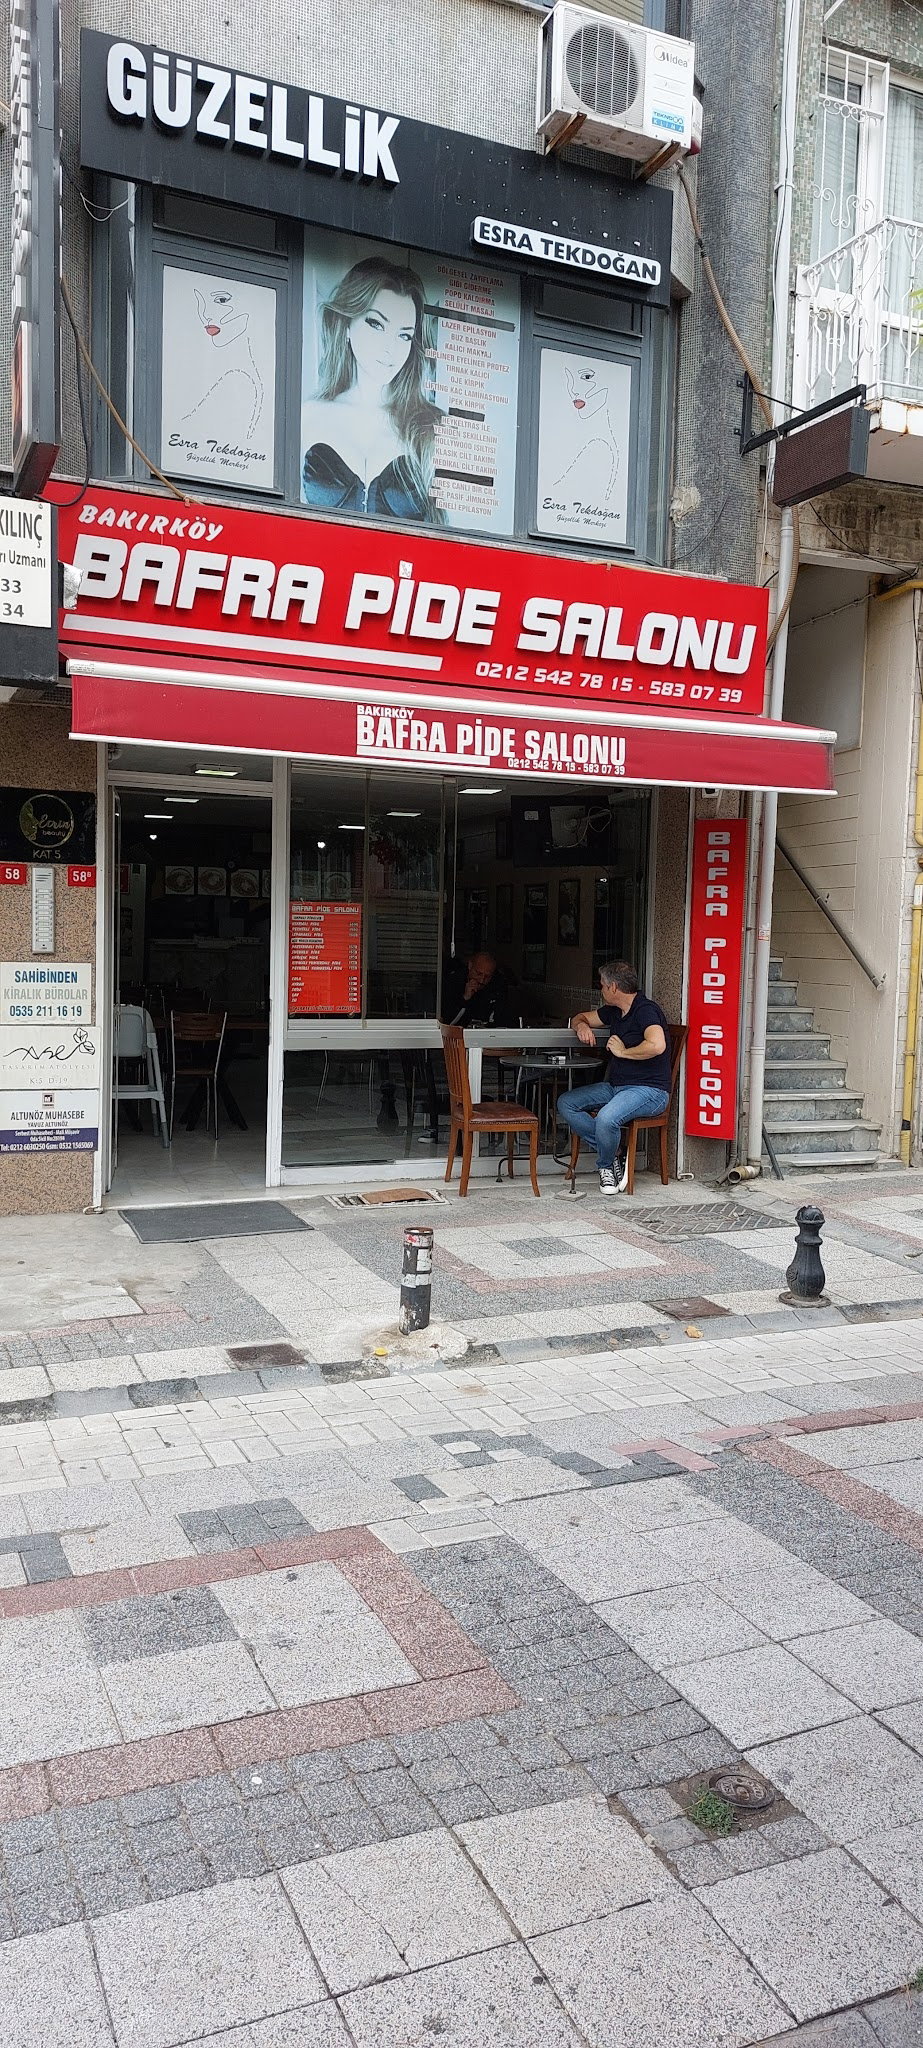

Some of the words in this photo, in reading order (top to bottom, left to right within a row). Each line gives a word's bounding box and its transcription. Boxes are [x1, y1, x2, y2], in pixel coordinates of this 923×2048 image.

[656, 48, 688, 68] Midea
[107, 42, 401, 184] GÜZELLİK
[479, 221, 533, 252] ESRA
[540, 238, 656, 281] TEKDOĞAN
[444, 289, 462, 299] POPO
[470, 305, 495, 317] MASAJI
[441, 320, 461, 330] LAZER
[462, 324, 497, 339] EPİLASYON
[451, 333, 464, 342] BUZ
[466, 347, 492, 359] MAKYAJ
[168, 433, 199, 450] Esra
[206, 440, 267, 462] Tekdoğan
[186, 452, 216, 464] Güzellik
[220, 457, 250, 471] Merkezi
[542, 497, 567, 512] Esra
[573, 502, 621, 521] Tekdoğan
[78, 504, 223, 542] BAKIRKÖY
[8, 549, 46, 569] Uzmanı
[0, 578, 22, 594] 33
[2, 602, 24, 618] 34
[72, 533, 325, 625] BAFRA
[344, 559, 501, 646] PİDE
[516, 596, 758, 675] SALONU
[475, 661, 527, 682] 0212
[533, 667, 572, 687] 542
[578, 672, 604, 689] 78
[610, 676, 634, 692] 15
[648, 680, 686, 698] 583
[690, 684, 715, 701] 07
[718, 688, 743, 704] 39
[356, 704, 414, 720] BAKIRKÖY
[356, 715, 447, 753] BAFRA
[456, 718, 516, 758] PİDE
[524, 729, 626, 766] SALONU
[508, 757, 530, 769] 0212
[532, 759, 549, 771] 542
[552, 760, 563, 772] 78
[565, 762, 576, 772] 15
[583, 763, 599, 774] 583
[602, 764, 612, 774] 07
[614, 764, 626, 776] 39
[32, 850, 52, 859] KAT
[54, 850, 61, 859] 5
[5, 868, 20, 880] 58
[705, 831, 731, 917] BAFRA
[14, 968, 78, 984] SAHİBİNDEN
[702, 937, 728, 1004] PİDE
[4, 986, 42, 1000] KİRALIK
[44, 986, 88, 1000] BÜROLAR
[10, 1006, 33, 1016] 0535
[36, 1006, 52, 1016] 211
[56, 1006, 68, 1016] 16
[70, 1006, 82, 1016] 19
[699, 1025, 724, 1127] SALONU
[10, 1110, 44, 1120] ALTUNÖZ
[45, 1110, 84, 1120] MUHASEBE
